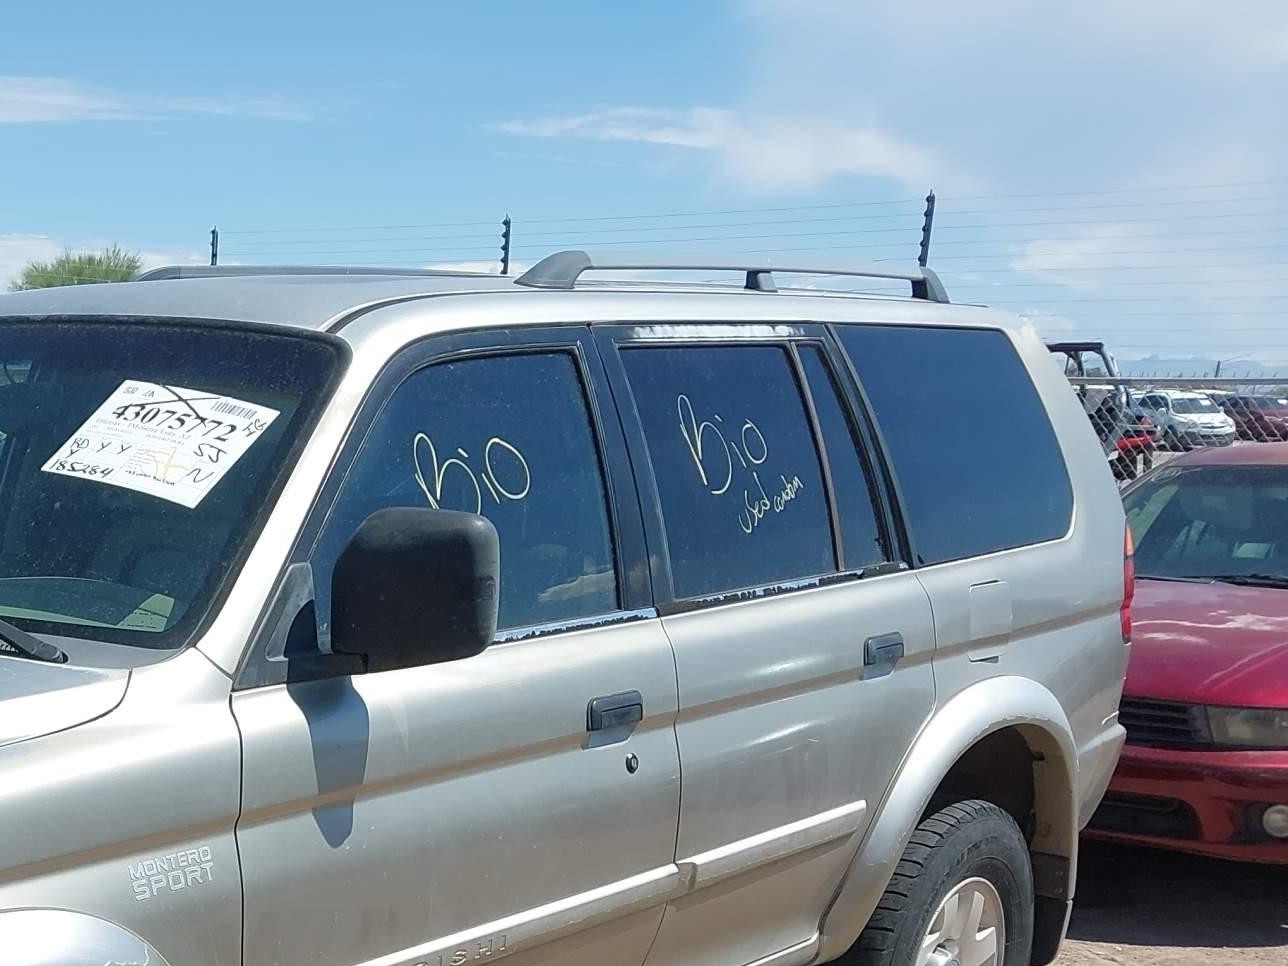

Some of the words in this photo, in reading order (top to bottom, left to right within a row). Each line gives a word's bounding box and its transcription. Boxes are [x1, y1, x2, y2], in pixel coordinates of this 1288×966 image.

[112, 403, 237, 442] 43075772
[127, 845, 212, 881] MONTERO
[131, 861, 214, 902] SPORT
